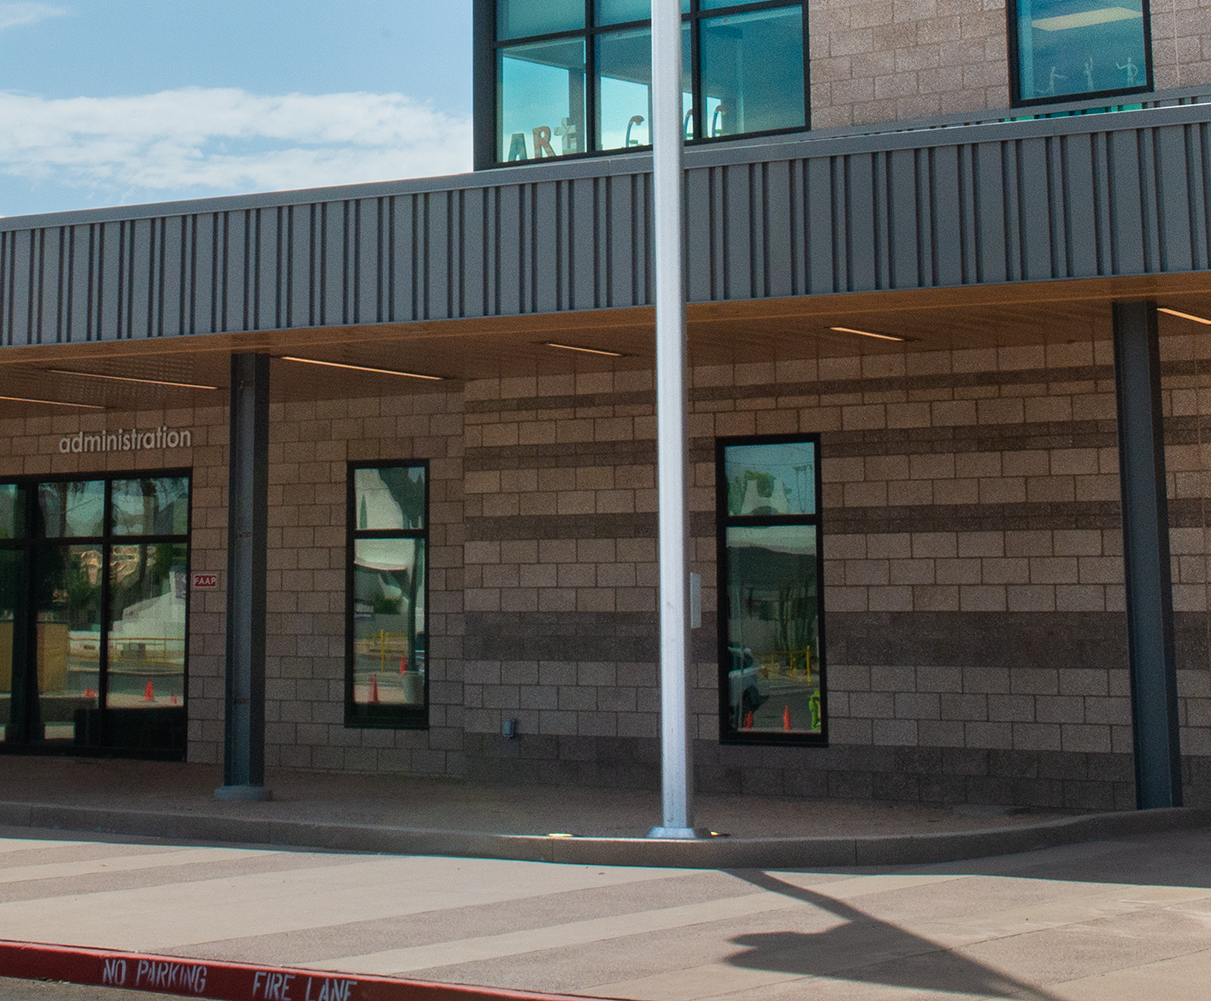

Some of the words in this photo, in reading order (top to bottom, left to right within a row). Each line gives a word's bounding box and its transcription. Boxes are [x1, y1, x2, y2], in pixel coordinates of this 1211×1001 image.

[59, 425, 191, 453] administration
[103, 958, 127, 985] NO
[136, 959, 207, 993] PARKING
[252, 971, 296, 1000] FIRE
